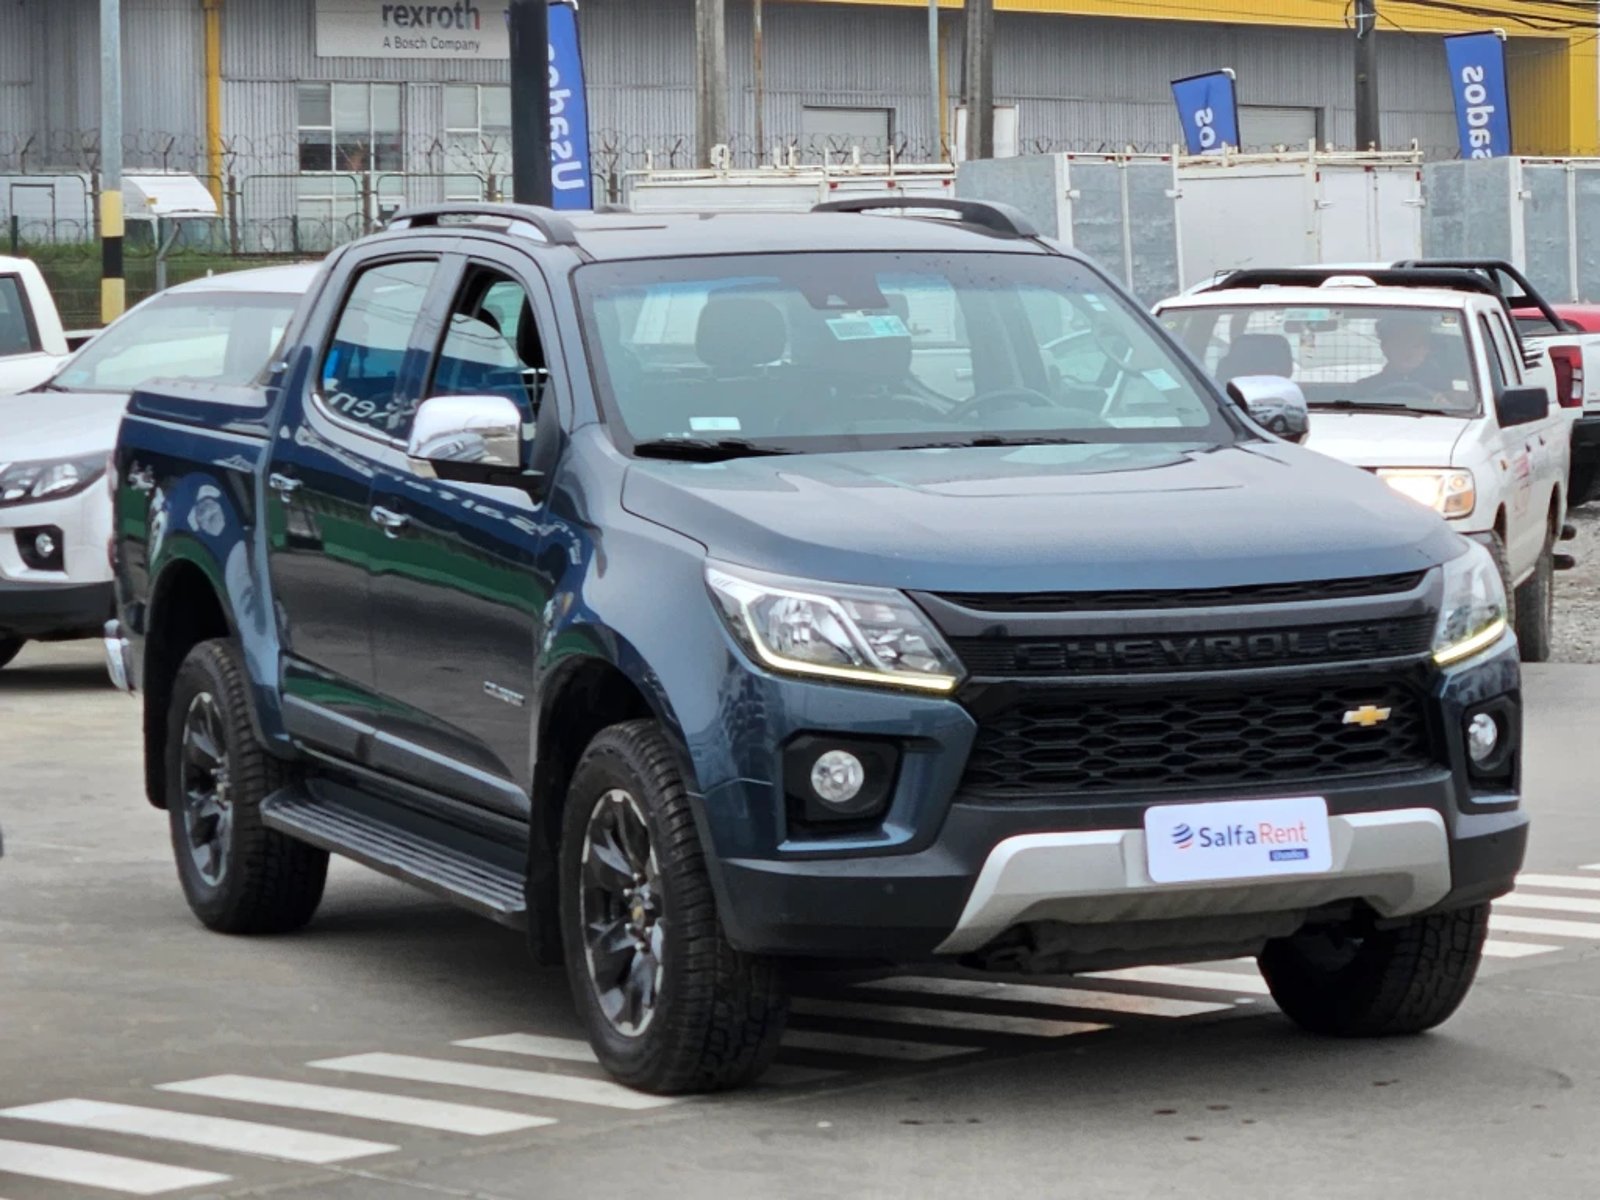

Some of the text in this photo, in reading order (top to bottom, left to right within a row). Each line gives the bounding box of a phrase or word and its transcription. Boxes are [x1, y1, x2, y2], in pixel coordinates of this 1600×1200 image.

[382, 0, 480, 29] rexroth
[384, 36, 480, 53] A Bosch Company
[1014, 627, 1399, 670] CHEVROLET
